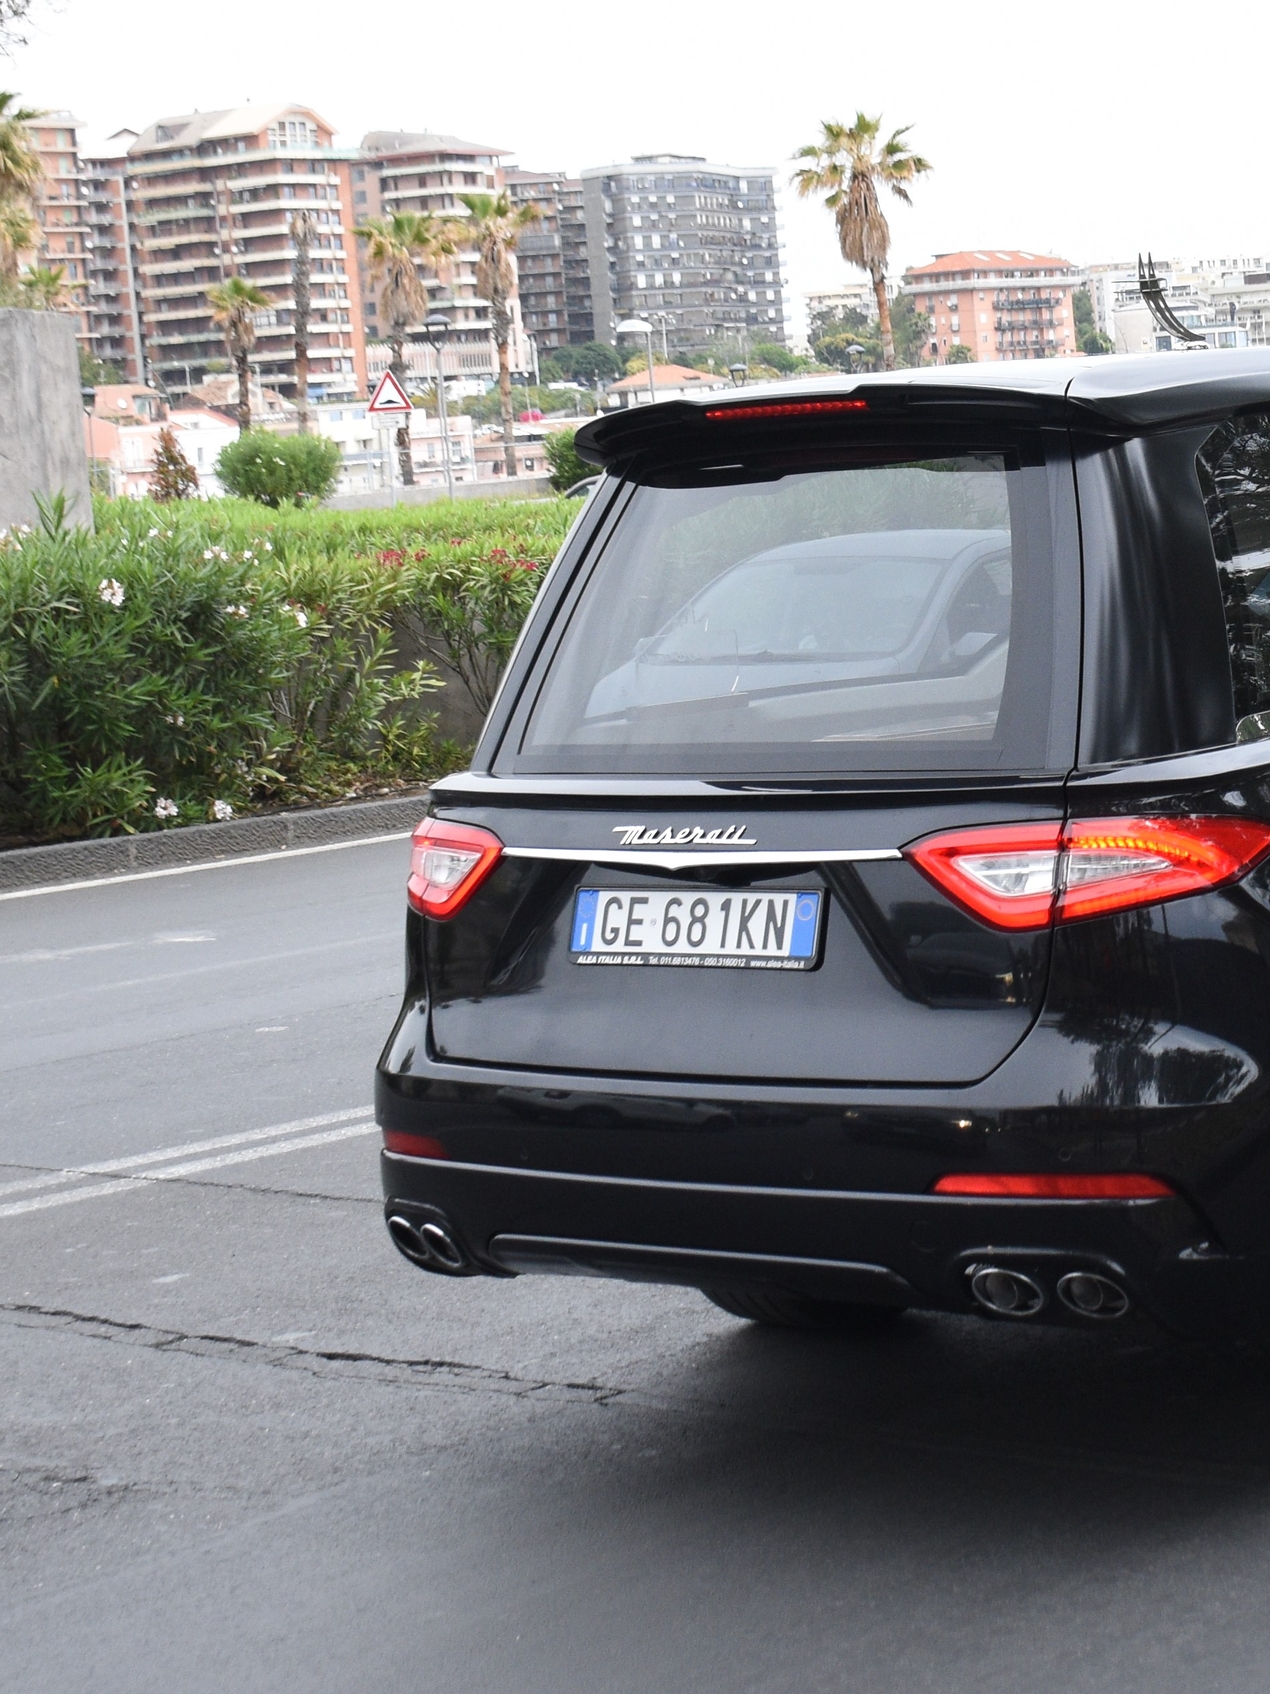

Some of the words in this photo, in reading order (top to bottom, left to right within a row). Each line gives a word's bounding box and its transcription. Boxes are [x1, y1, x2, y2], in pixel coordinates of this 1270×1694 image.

[612, 825, 757, 846] Maserati
[600, 896, 650, 947] GE
[661, 897, 790, 950] 681KN
[577, 955, 597, 964] ALEA
[597, 955, 622, 965] ITALIA
